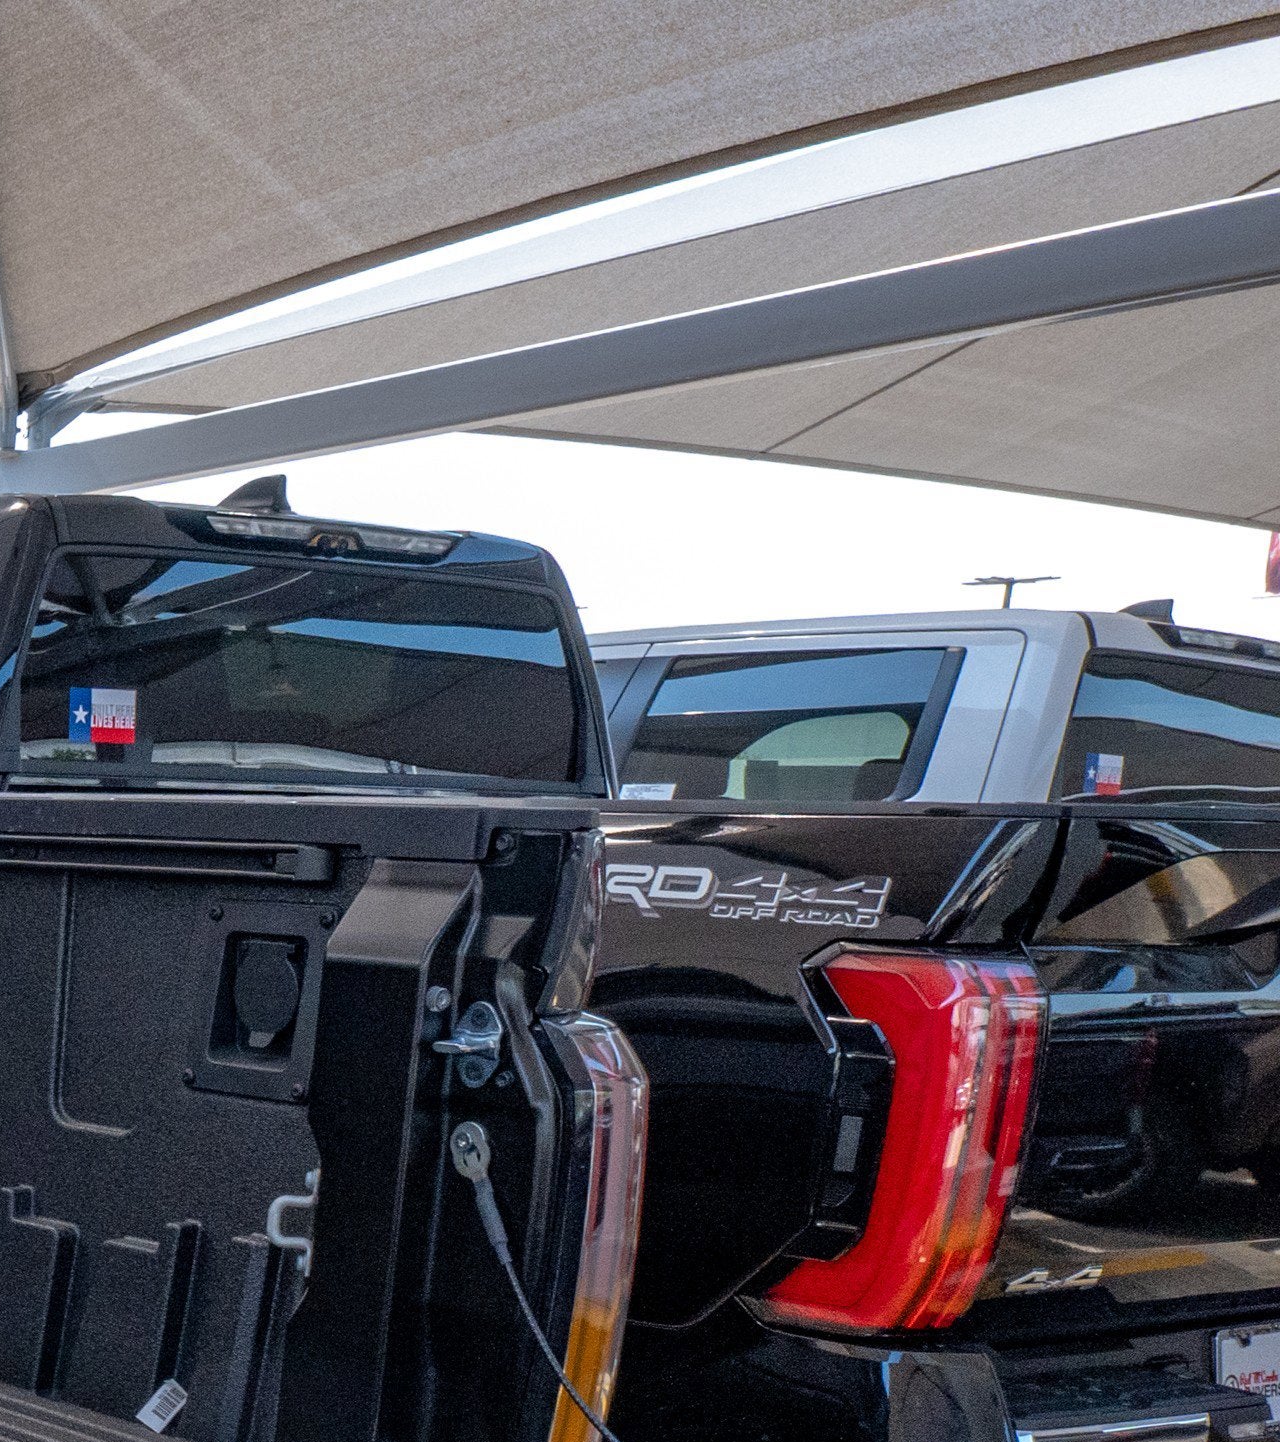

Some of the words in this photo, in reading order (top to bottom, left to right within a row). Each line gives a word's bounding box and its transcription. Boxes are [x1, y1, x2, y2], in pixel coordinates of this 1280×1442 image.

[91, 715, 113, 728] LIVES
[114, 716, 136, 729] HERE
[709, 904, 777, 920] OFF
[779, 909, 881, 929] ROAD
